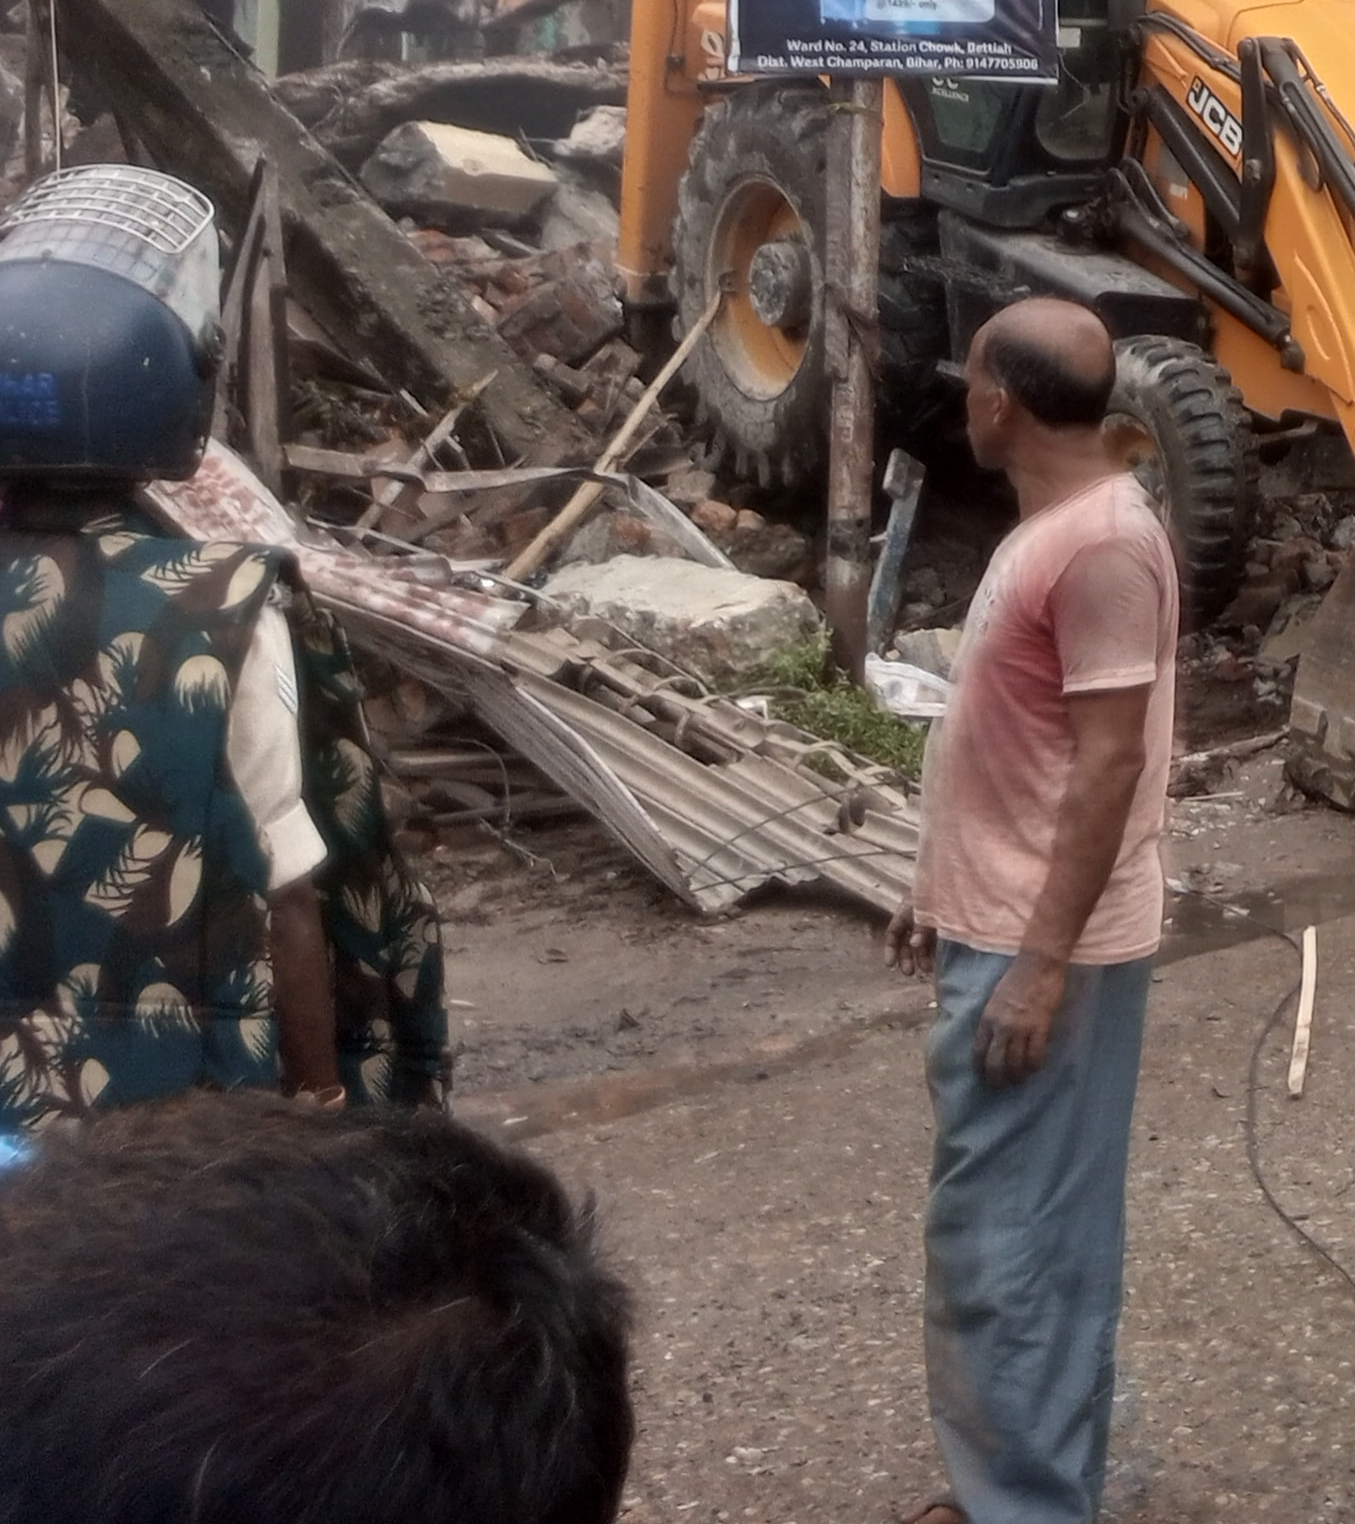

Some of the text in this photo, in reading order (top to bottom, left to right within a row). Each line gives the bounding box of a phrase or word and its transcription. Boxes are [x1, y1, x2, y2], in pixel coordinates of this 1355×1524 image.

[787, 39, 822, 52] Ward
[825, 40, 847, 52] No.
[849, 40, 868, 54] 24,
[870, 41, 916, 53] Station
[967, 42, 1012, 55] Bettiah
[757, 56, 788, 68] Dist.
[791, 56, 824, 68] West
[827, 56, 903, 71] Champaran,
[906, 57, 942, 70] Bihar,
[1187, 79, 1242, 156] JCB
